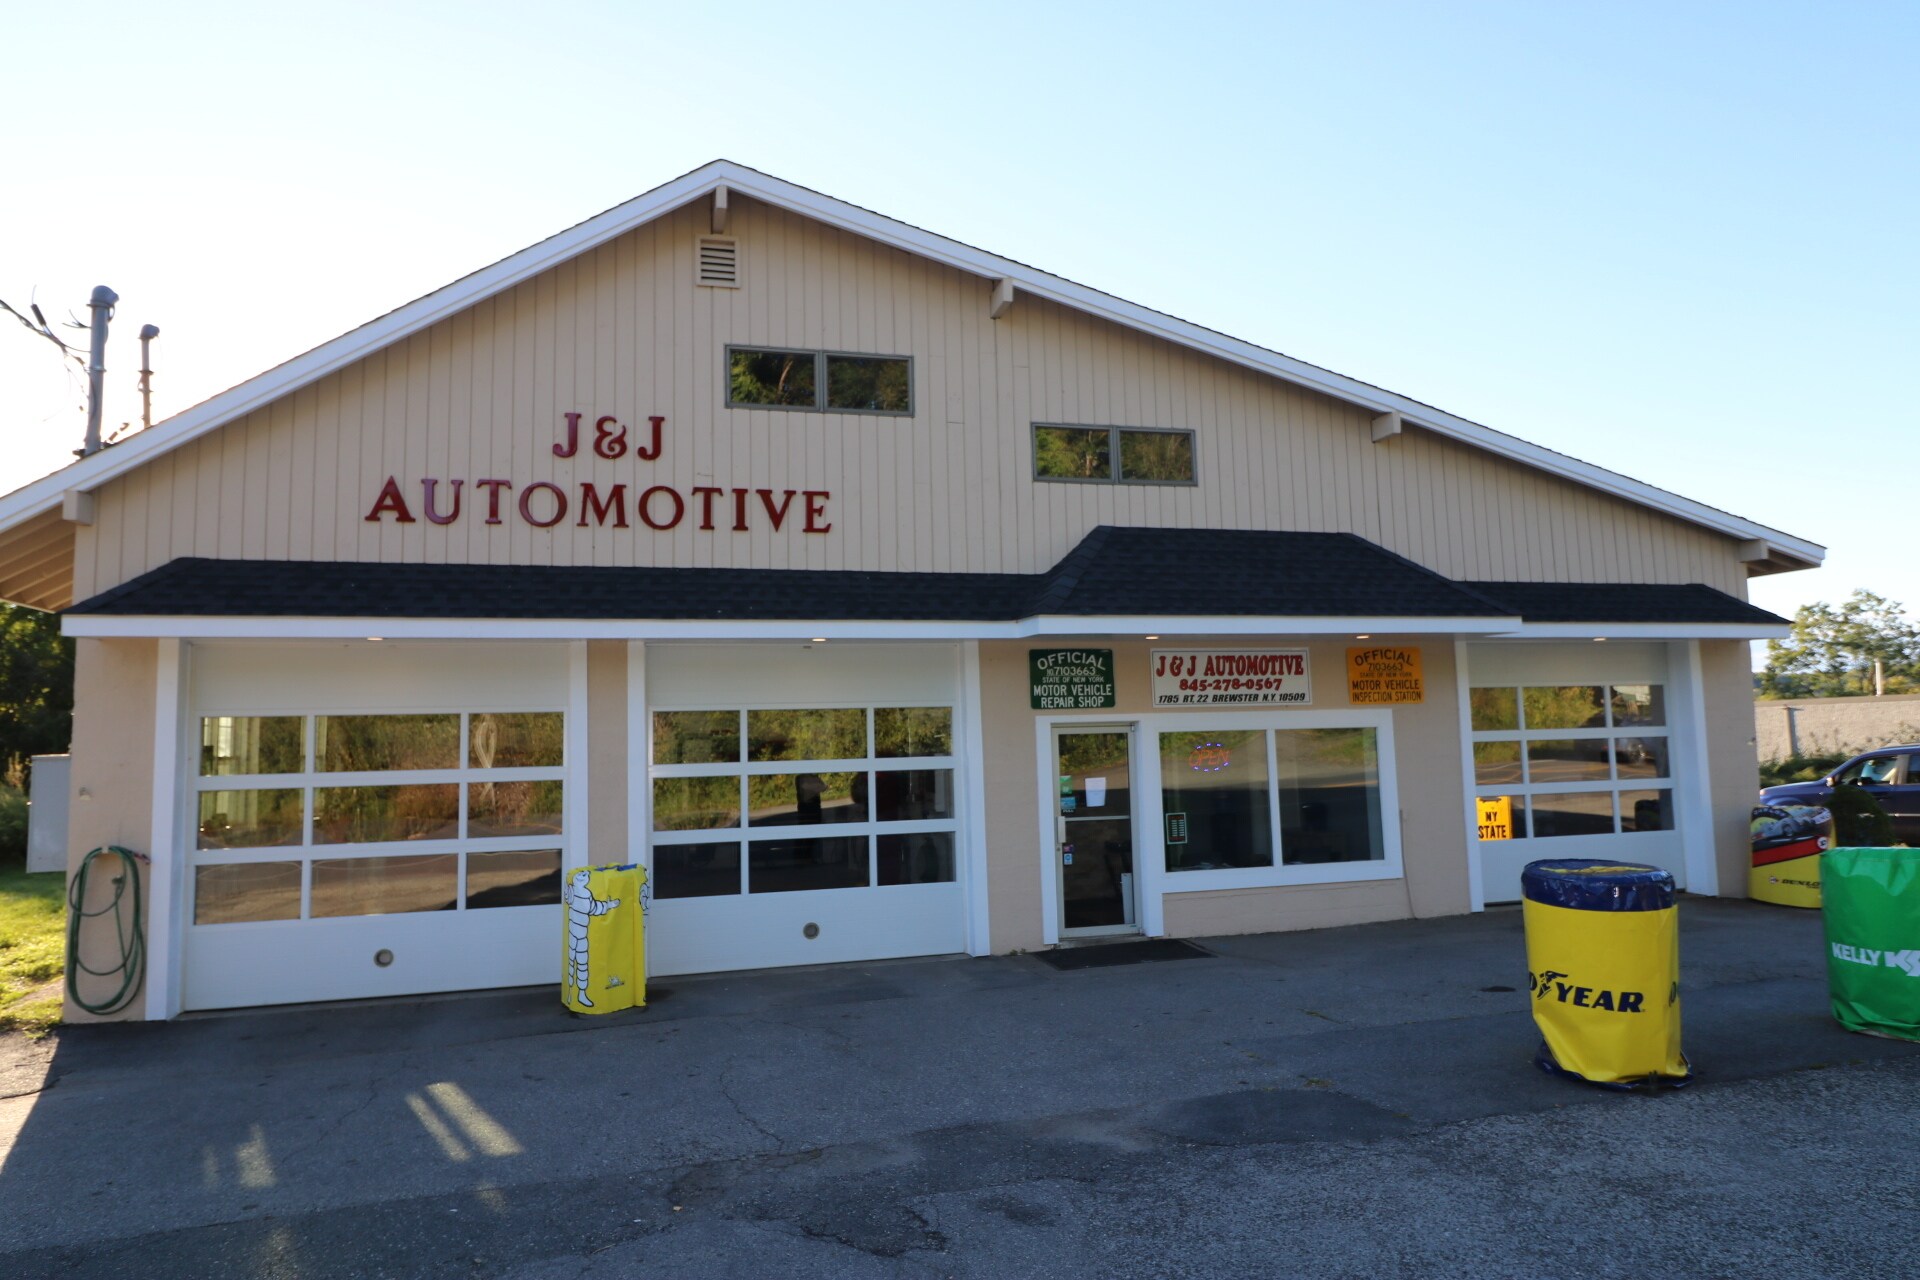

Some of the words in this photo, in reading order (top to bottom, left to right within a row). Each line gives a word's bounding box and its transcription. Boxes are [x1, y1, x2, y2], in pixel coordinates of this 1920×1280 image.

[364, 475, 832, 533] AUTOMOTIVE
[1037, 651, 1106, 670] OFFICIAL
[1354, 649, 1414, 666] OFFICIAL
[1054, 666, 1096, 676] 7103663
[1203, 654, 1304, 677] AUTOMOTIVE
[1368, 662, 1403, 671] 7103663
[1033, 684, 1067, 696] MOTOR
[1071, 684, 1112, 696] VEHICLE
[1179, 678, 1282, 691] 845-278-0567
[1352, 680, 1381, 691] MOTOR
[1385, 679, 1420, 690] VEHICLE
[1041, 697, 1074, 709] REPAIR
[1078, 696, 1105, 708] SHOP
[1158, 694, 1179, 703] 1785
[1197, 694, 1209, 703] 22
[1211, 693, 1259, 703] BREWSTER
[1278, 692, 1306, 701] 10509
[1352, 691, 1392, 703] INSPECTION
[1394, 690, 1422, 702] STATION
[1189, 748, 1233, 767] OPEN
[1485, 811, 1498, 822] NY
[1478, 825, 1507, 839] STATE
[1831, 942, 1882, 967] KELLY
